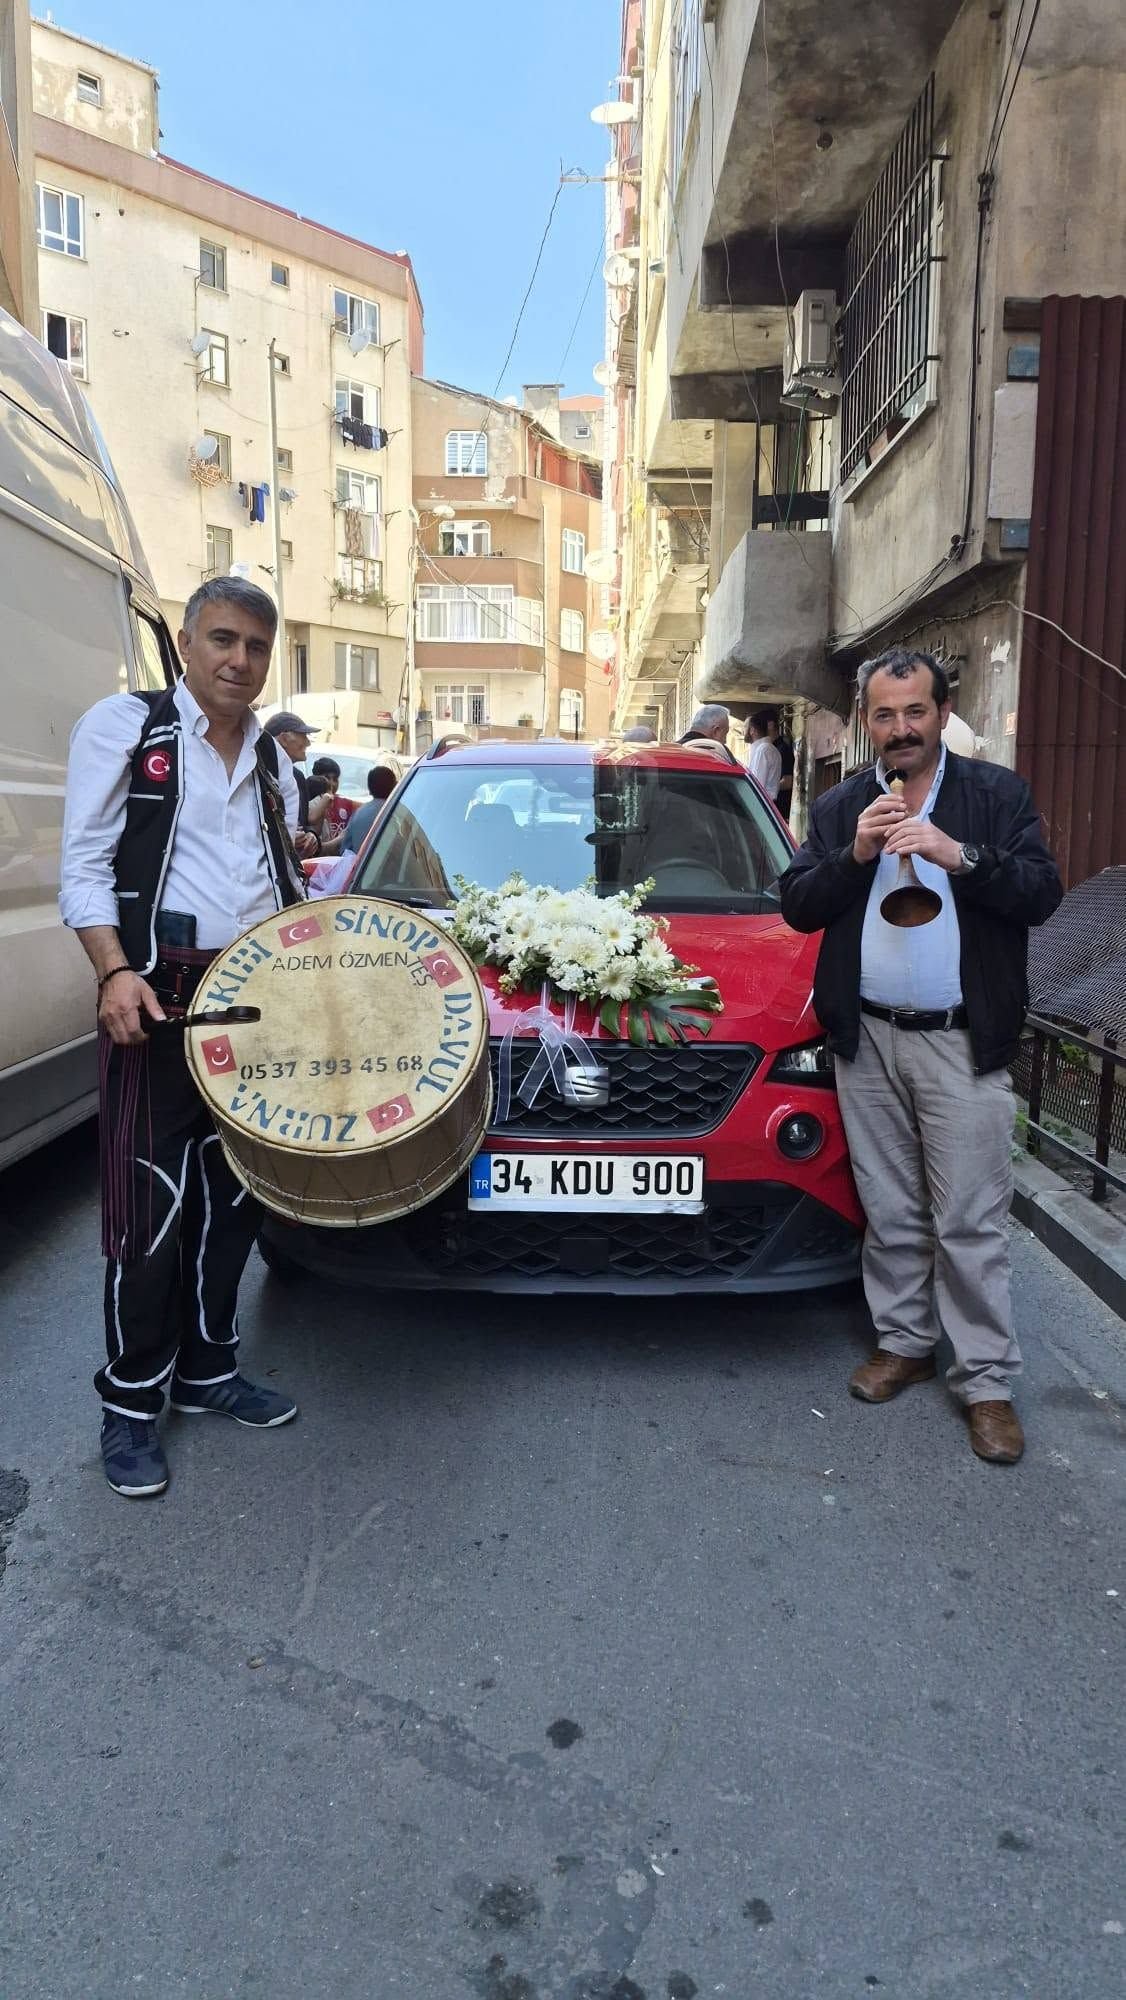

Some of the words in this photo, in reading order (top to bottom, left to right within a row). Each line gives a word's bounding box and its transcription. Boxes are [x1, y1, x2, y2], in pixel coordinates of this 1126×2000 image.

[334, 906, 439, 952] SİNOP
[272, 955, 332, 972] ADEM
[339, 951, 434, 987] ÖZMENTEŞ
[415, 992, 472, 1093] DAVUL
[240, 1061, 297, 1080] 0537
[308, 1058, 352, 1077] 393
[360, 1056, 388, 1074] 45
[396, 1055, 423, 1071] 68
[230, 1083, 357, 1142] ZURNA
[475, 1179, 489, 1190] TR
[492, 1159, 533, 1194] 34
[551, 1160, 614, 1196] KDU
[632, 1161, 694, 1196] 900
